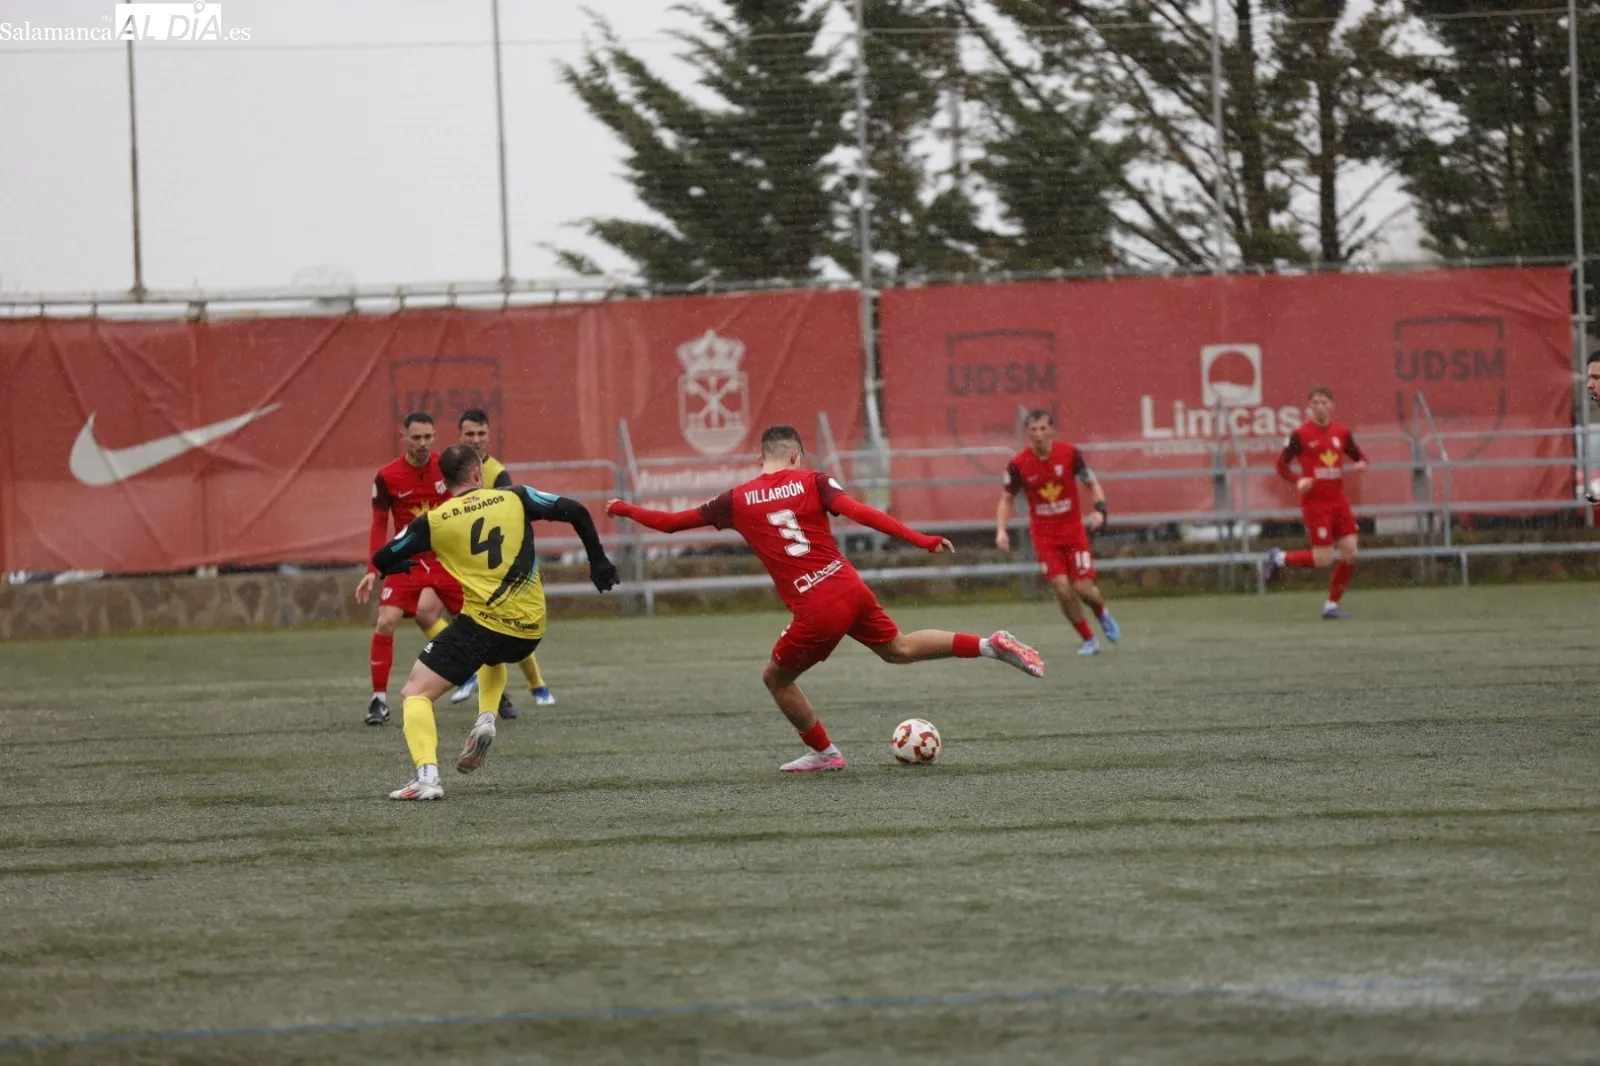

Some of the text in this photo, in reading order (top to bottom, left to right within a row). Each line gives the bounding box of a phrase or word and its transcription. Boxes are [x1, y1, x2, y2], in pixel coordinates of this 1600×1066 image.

[947, 362, 1057, 396] UDSM
[1395, 348, 1505, 381] UDSM
[744, 480, 805, 505] VILLARDÓN
[470, 517, 505, 570] 4
[766, 509, 811, 557] 3
